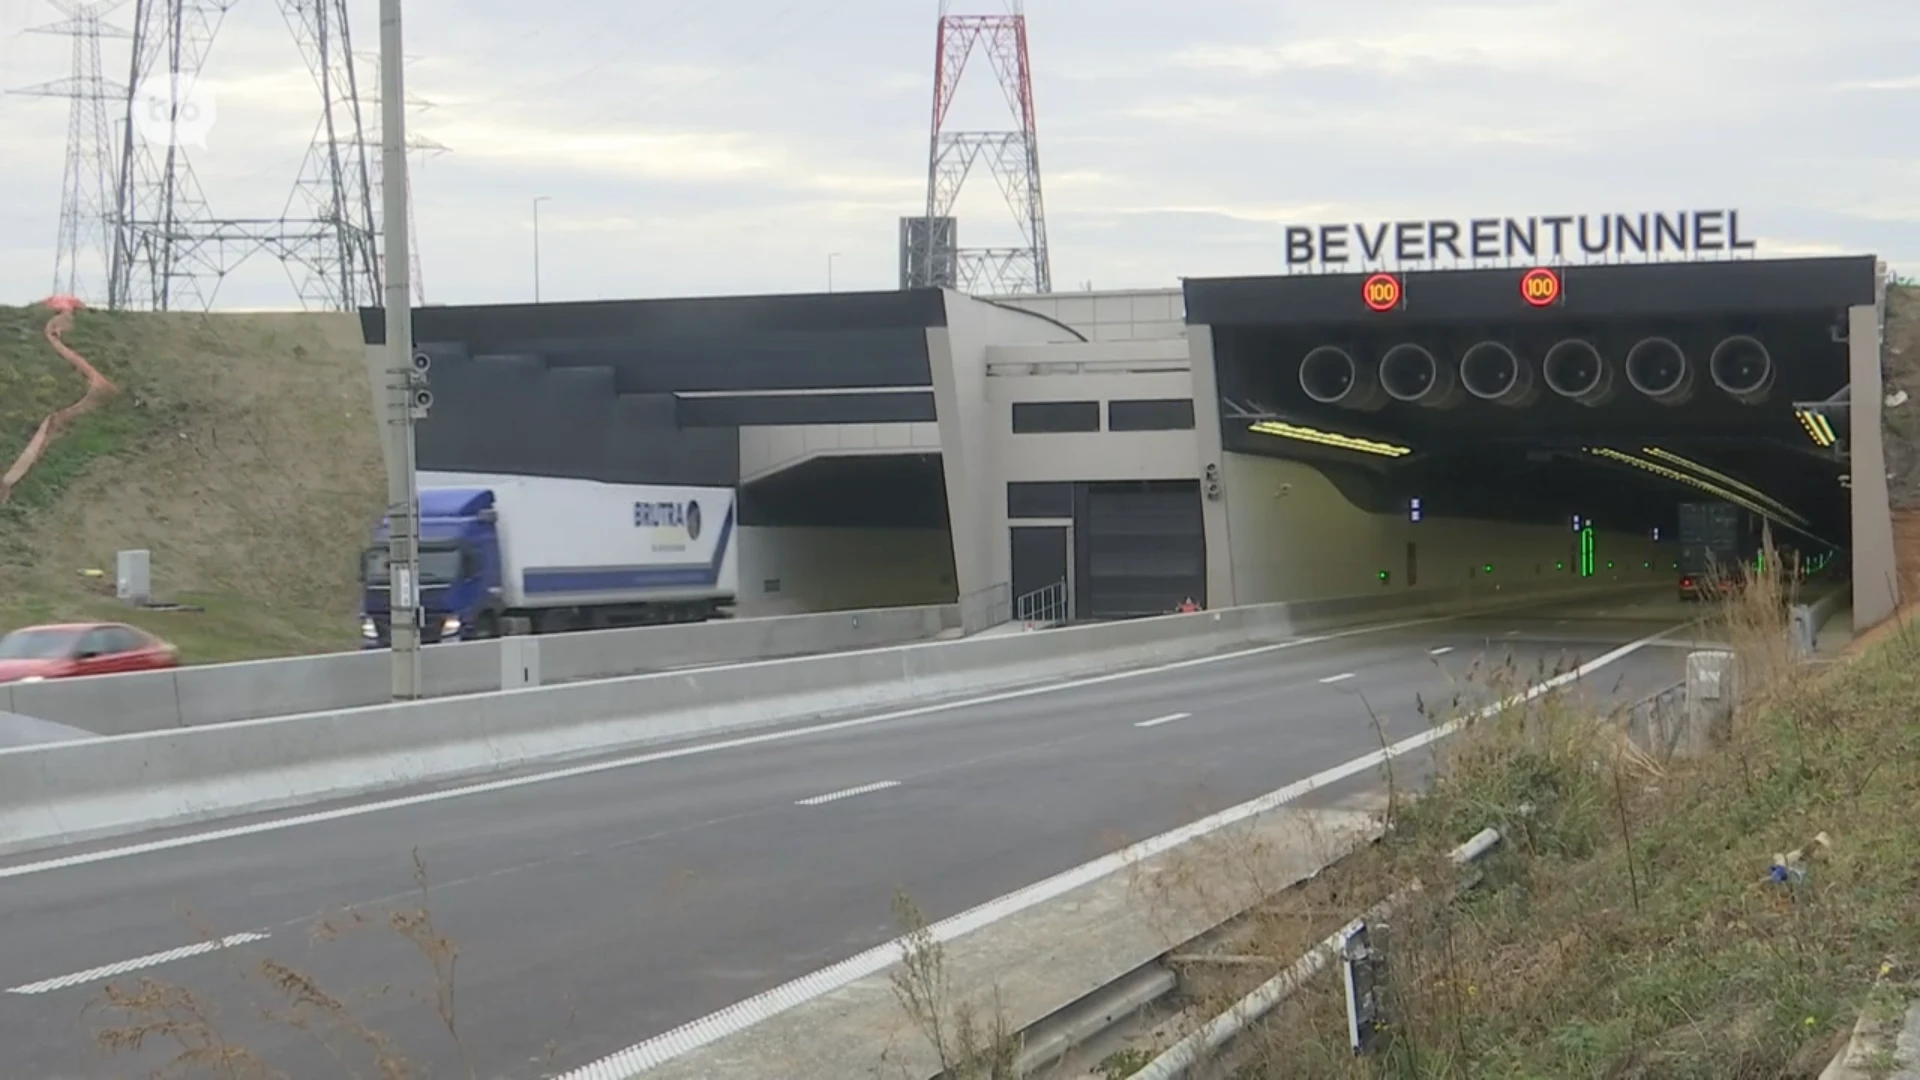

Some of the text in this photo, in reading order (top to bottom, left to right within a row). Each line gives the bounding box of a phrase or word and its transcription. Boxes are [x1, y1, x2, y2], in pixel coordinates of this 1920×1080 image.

[1285, 209, 1756, 265] BEVERENTUNNEL
[1369, 284, 1395, 301] 100
[1528, 278, 1553, 296] 100
[634, 501, 684, 527] BRUTRA
